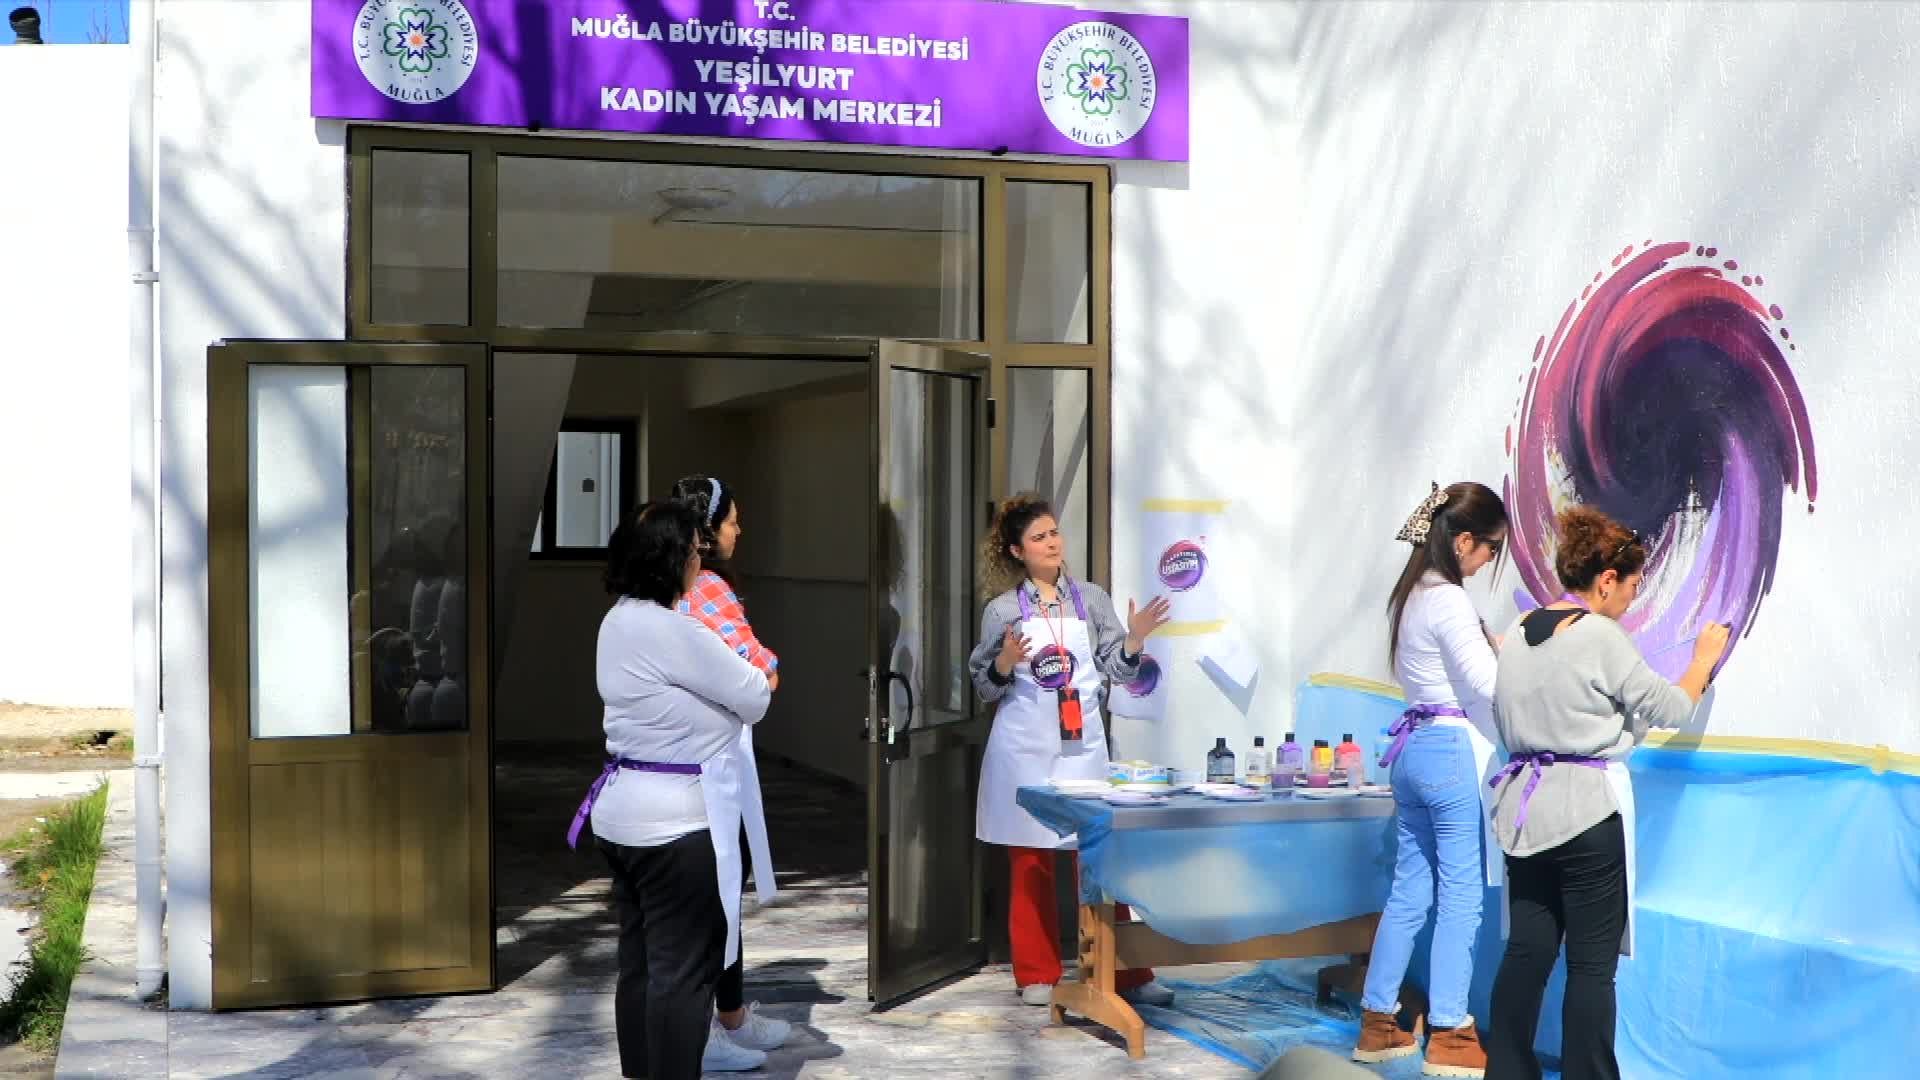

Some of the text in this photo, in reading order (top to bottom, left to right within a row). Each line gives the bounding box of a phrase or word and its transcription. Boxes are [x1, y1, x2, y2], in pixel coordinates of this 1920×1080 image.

[754, 0, 796, 20] T.C.
[571, 14, 969, 61] MUĞLA BÜYÜKŞEHİR BELEDİYESİ
[386, 83, 444, 101] MUĞLA
[694, 55, 855, 92] YEŞİLYURT
[600, 86, 942, 128] KADIN YAŞAM MERKEZİ
